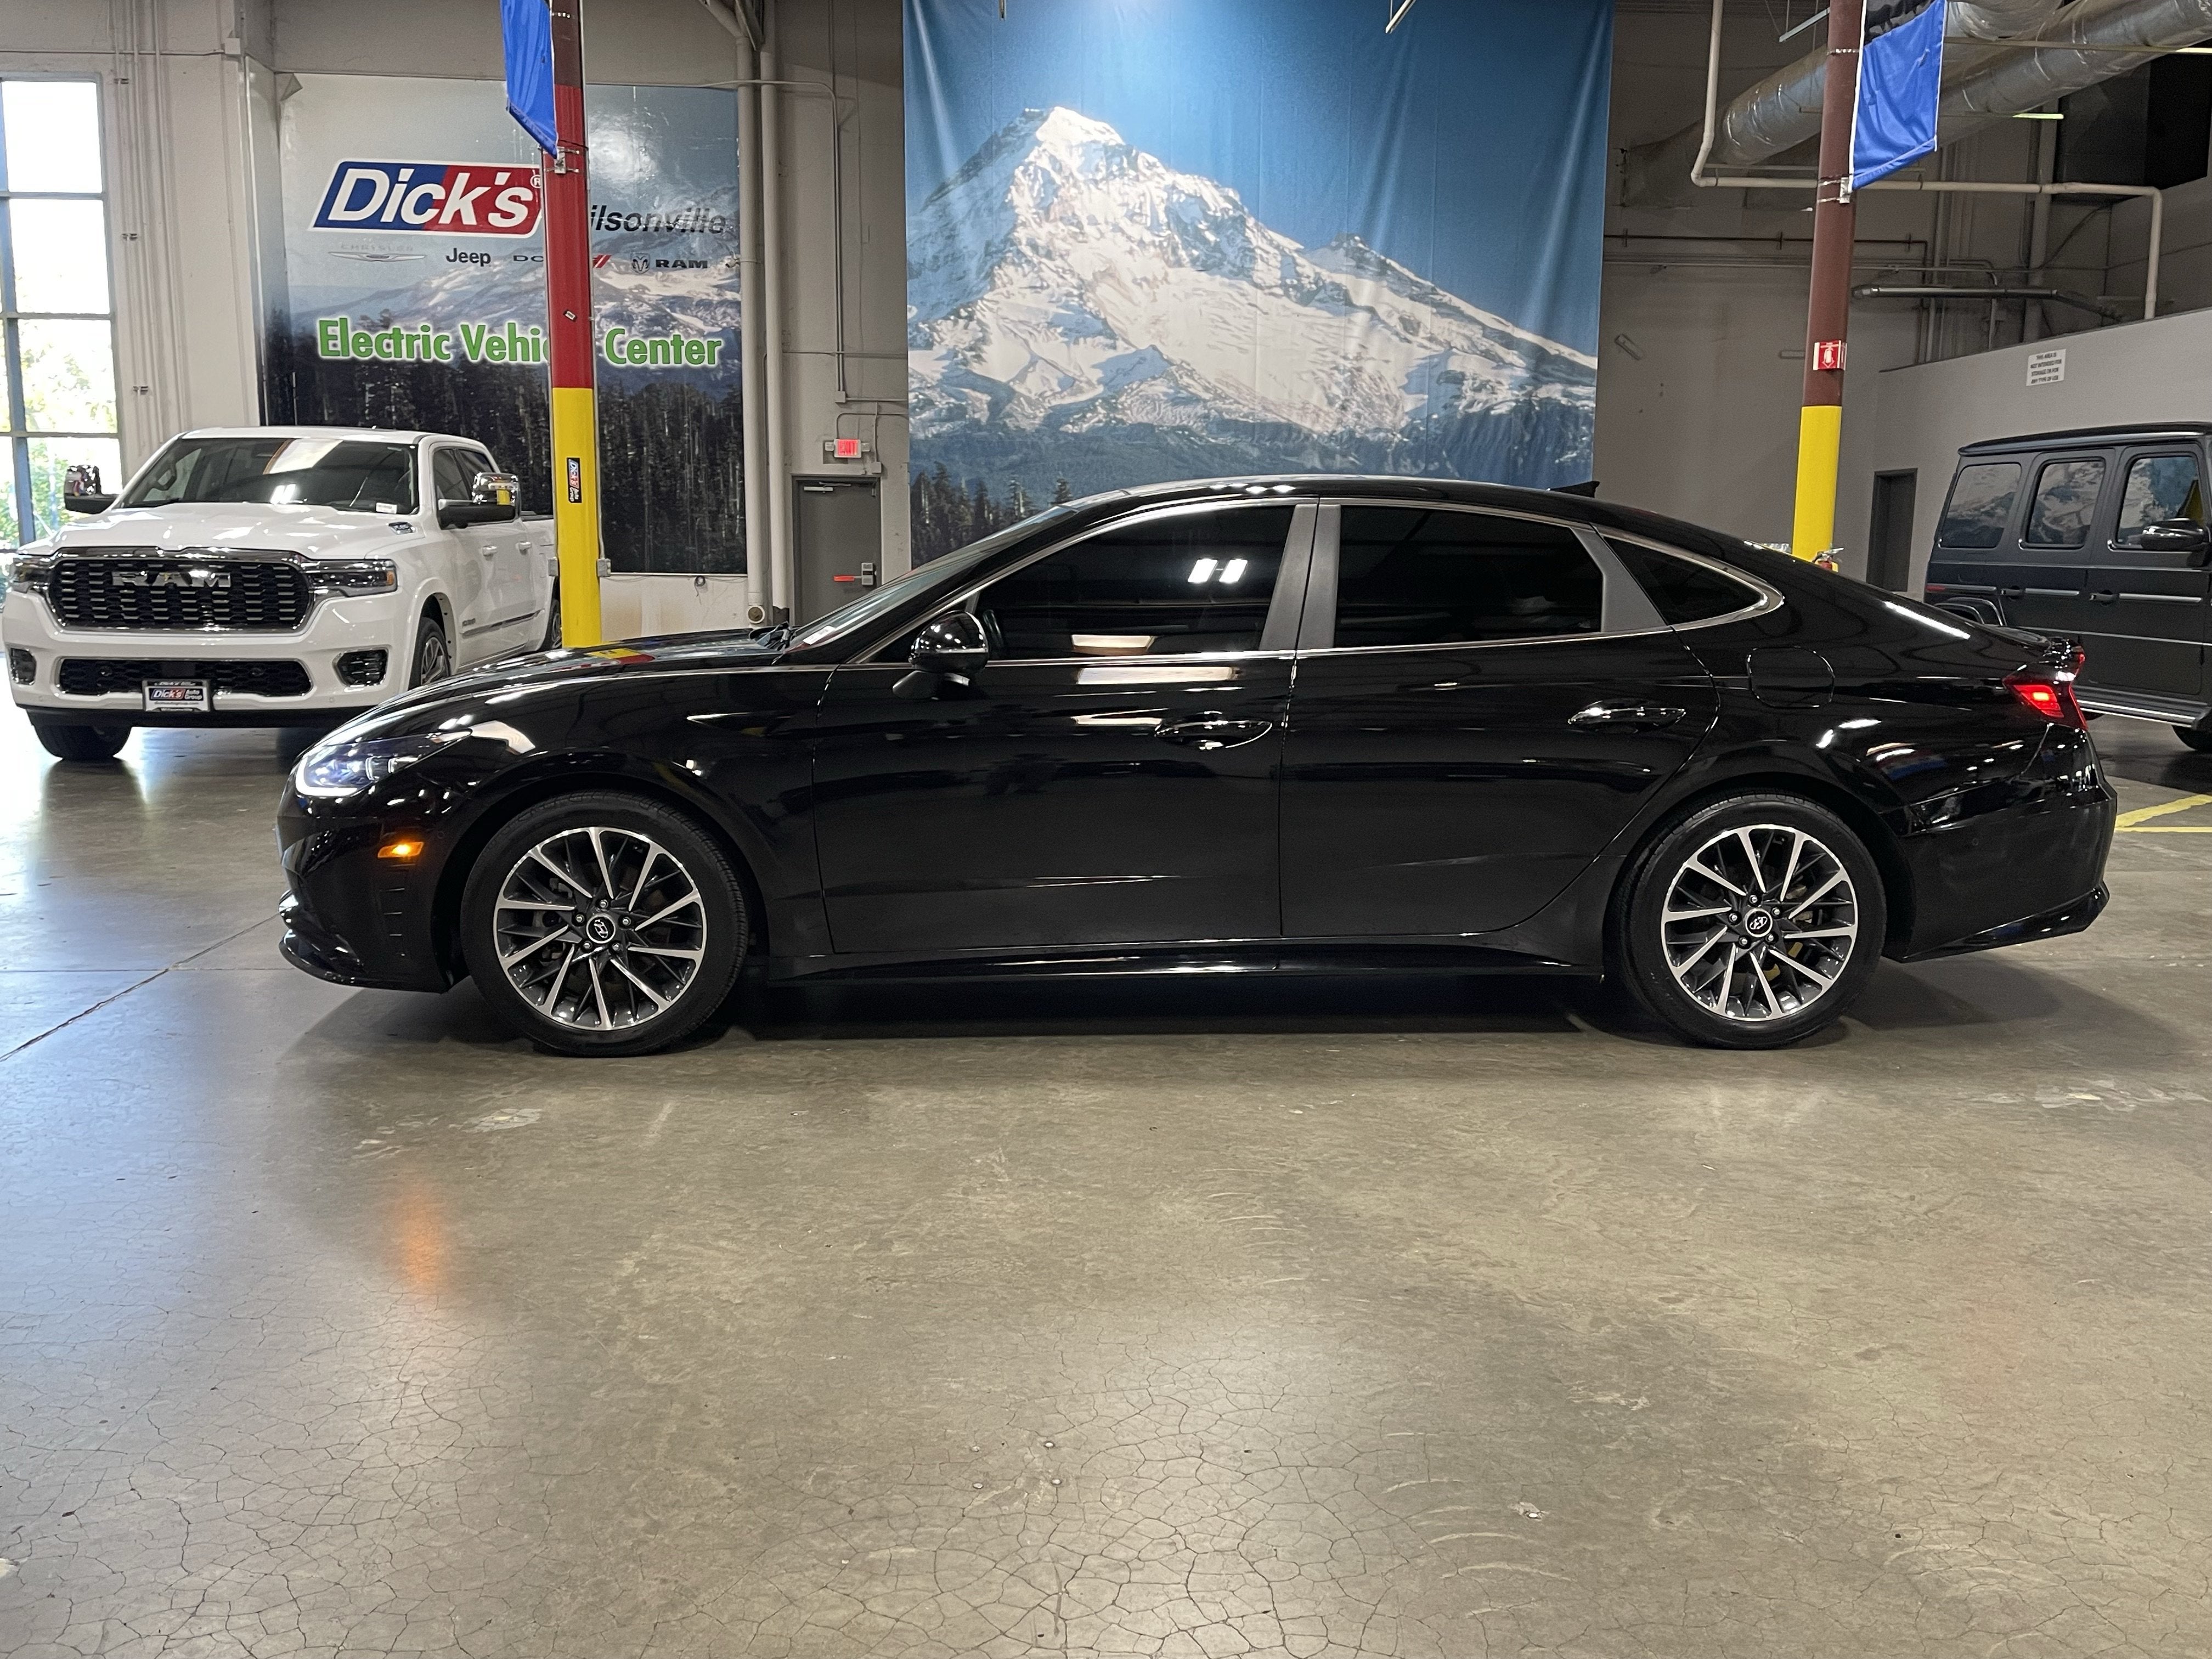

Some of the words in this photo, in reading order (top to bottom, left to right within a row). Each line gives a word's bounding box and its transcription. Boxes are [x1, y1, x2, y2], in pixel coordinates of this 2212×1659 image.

[328, 168, 533, 228] Dick's
[591, 205, 726, 234] ilsonville
[445, 247, 492, 267] Jeep
[656, 259, 708, 269] RAM
[318, 318, 451, 360] Electric
[606, 328, 722, 365] Center
[112, 571, 230, 587] RAM
[154, 689, 183, 698] Dick's
